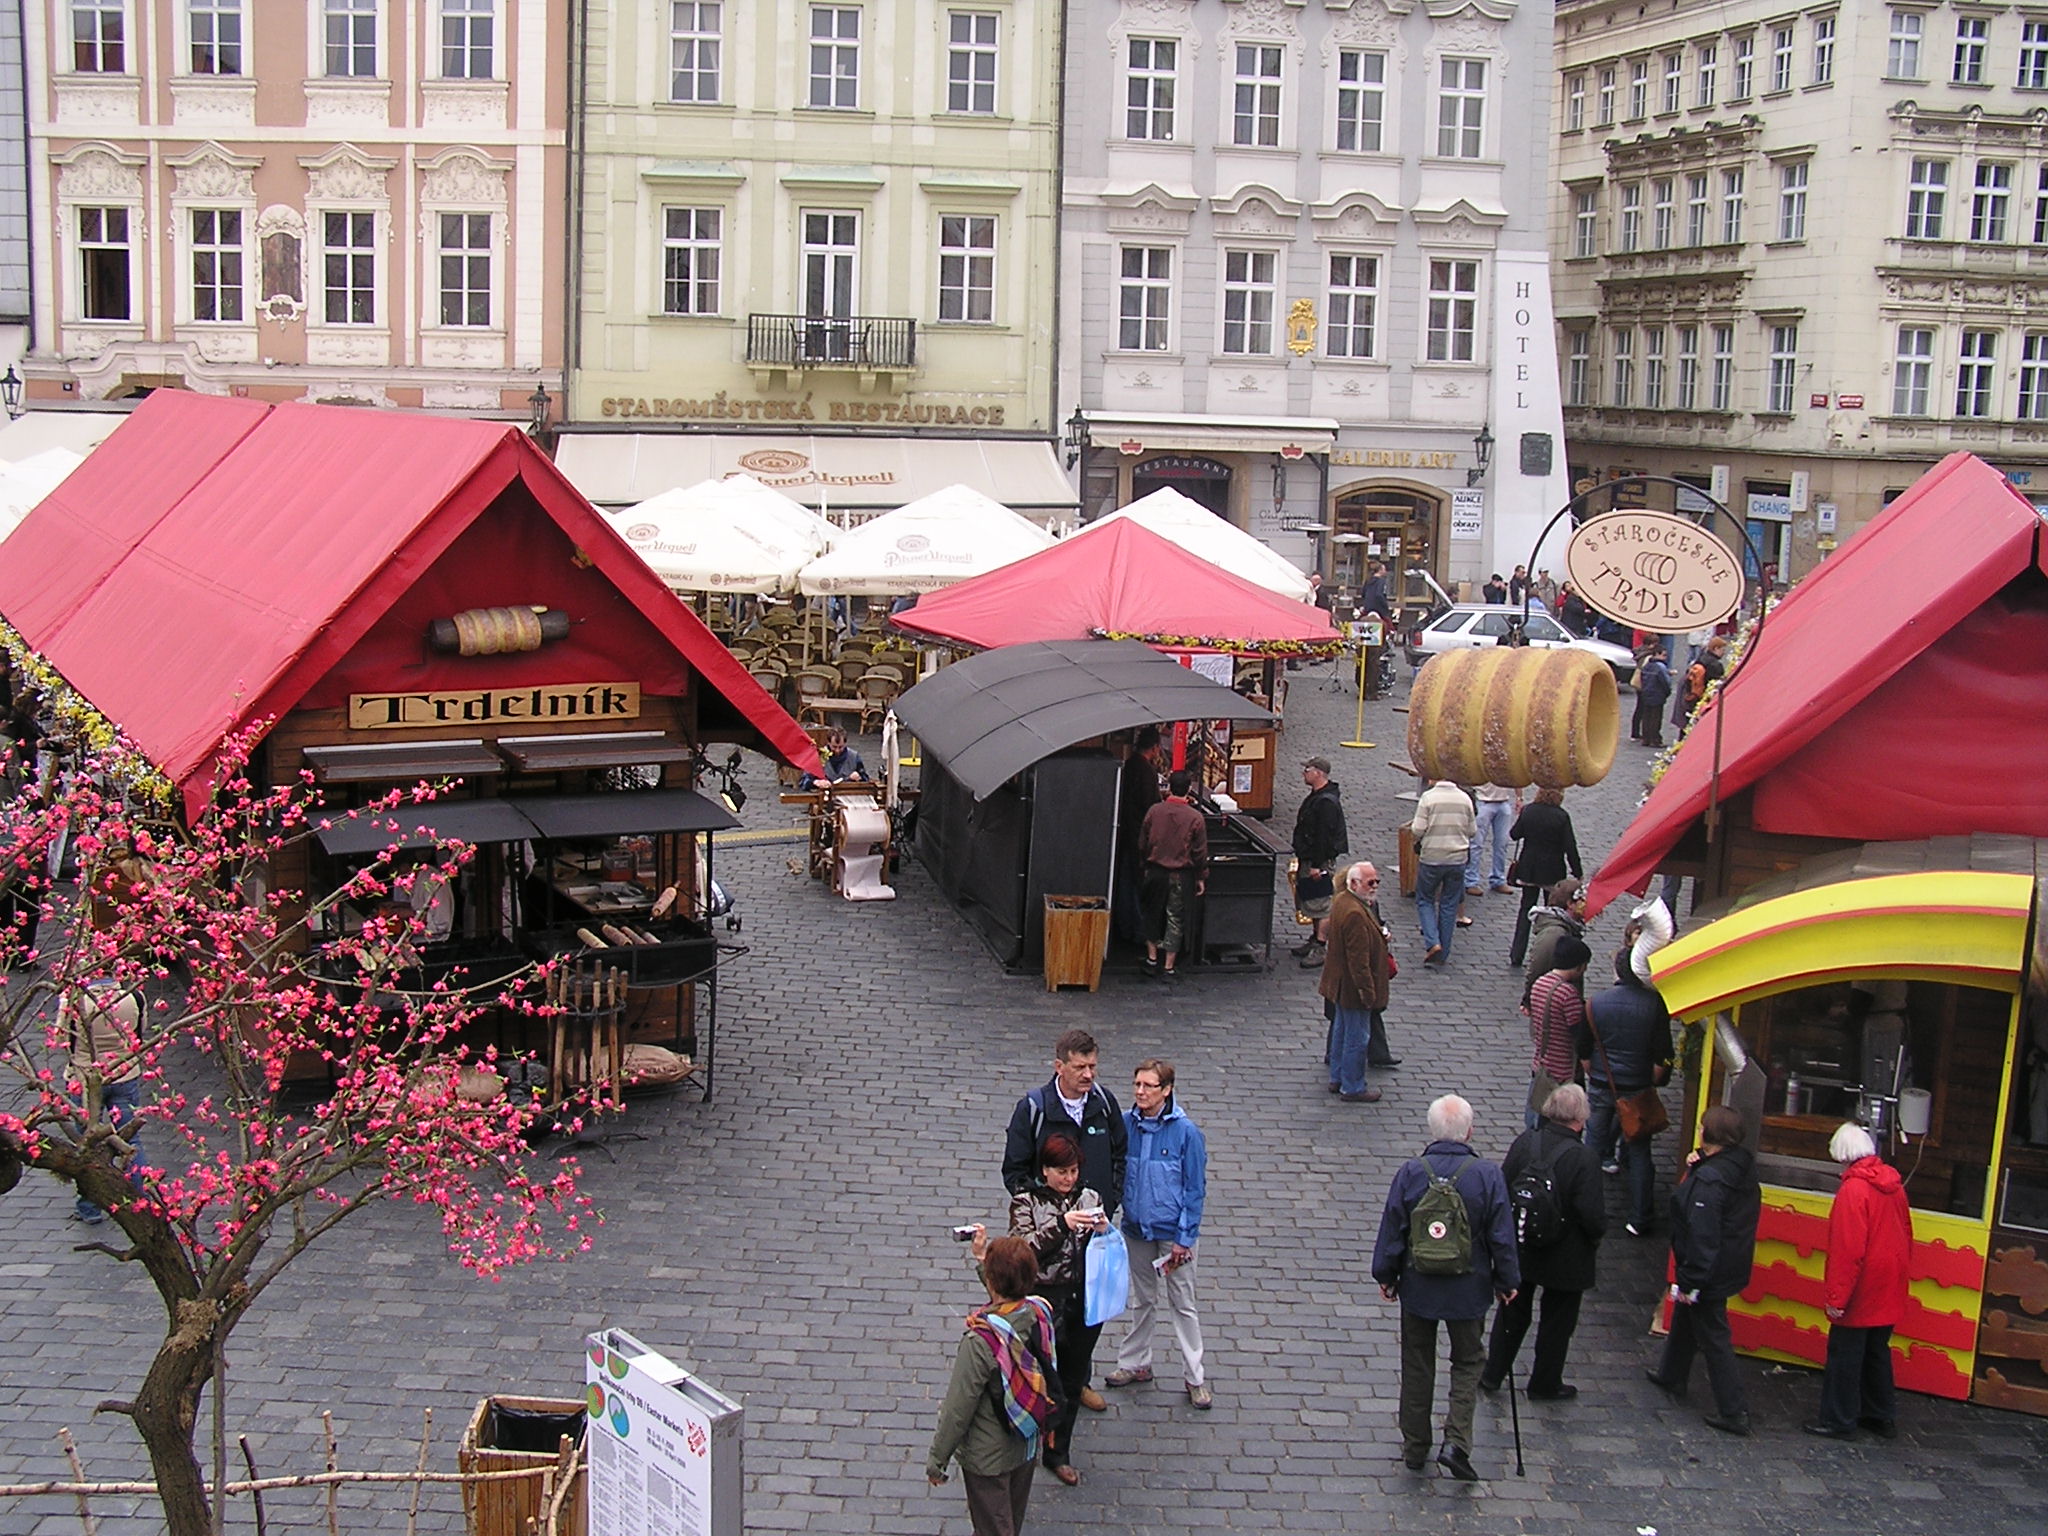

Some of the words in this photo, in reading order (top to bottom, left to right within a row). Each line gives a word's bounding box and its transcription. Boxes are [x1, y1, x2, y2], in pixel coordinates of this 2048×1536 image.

[1515, 282, 1531, 409] HOTEL
[601, 390, 815, 420] STAROMĚSTSKÁ
[829, 402, 1005, 425] RESTAURACE
[808, 470, 895, 486] Urquell
[1134, 459, 1229, 478] RESTAURANT
[1420, 453, 1457, 469] ART
[1585, 524, 1732, 584] STAROČESKÉ
[1591, 561, 1706, 619] TRDLO
[1358, 625, 1373, 634] WC
[358, 686, 629, 728] Trdelník
